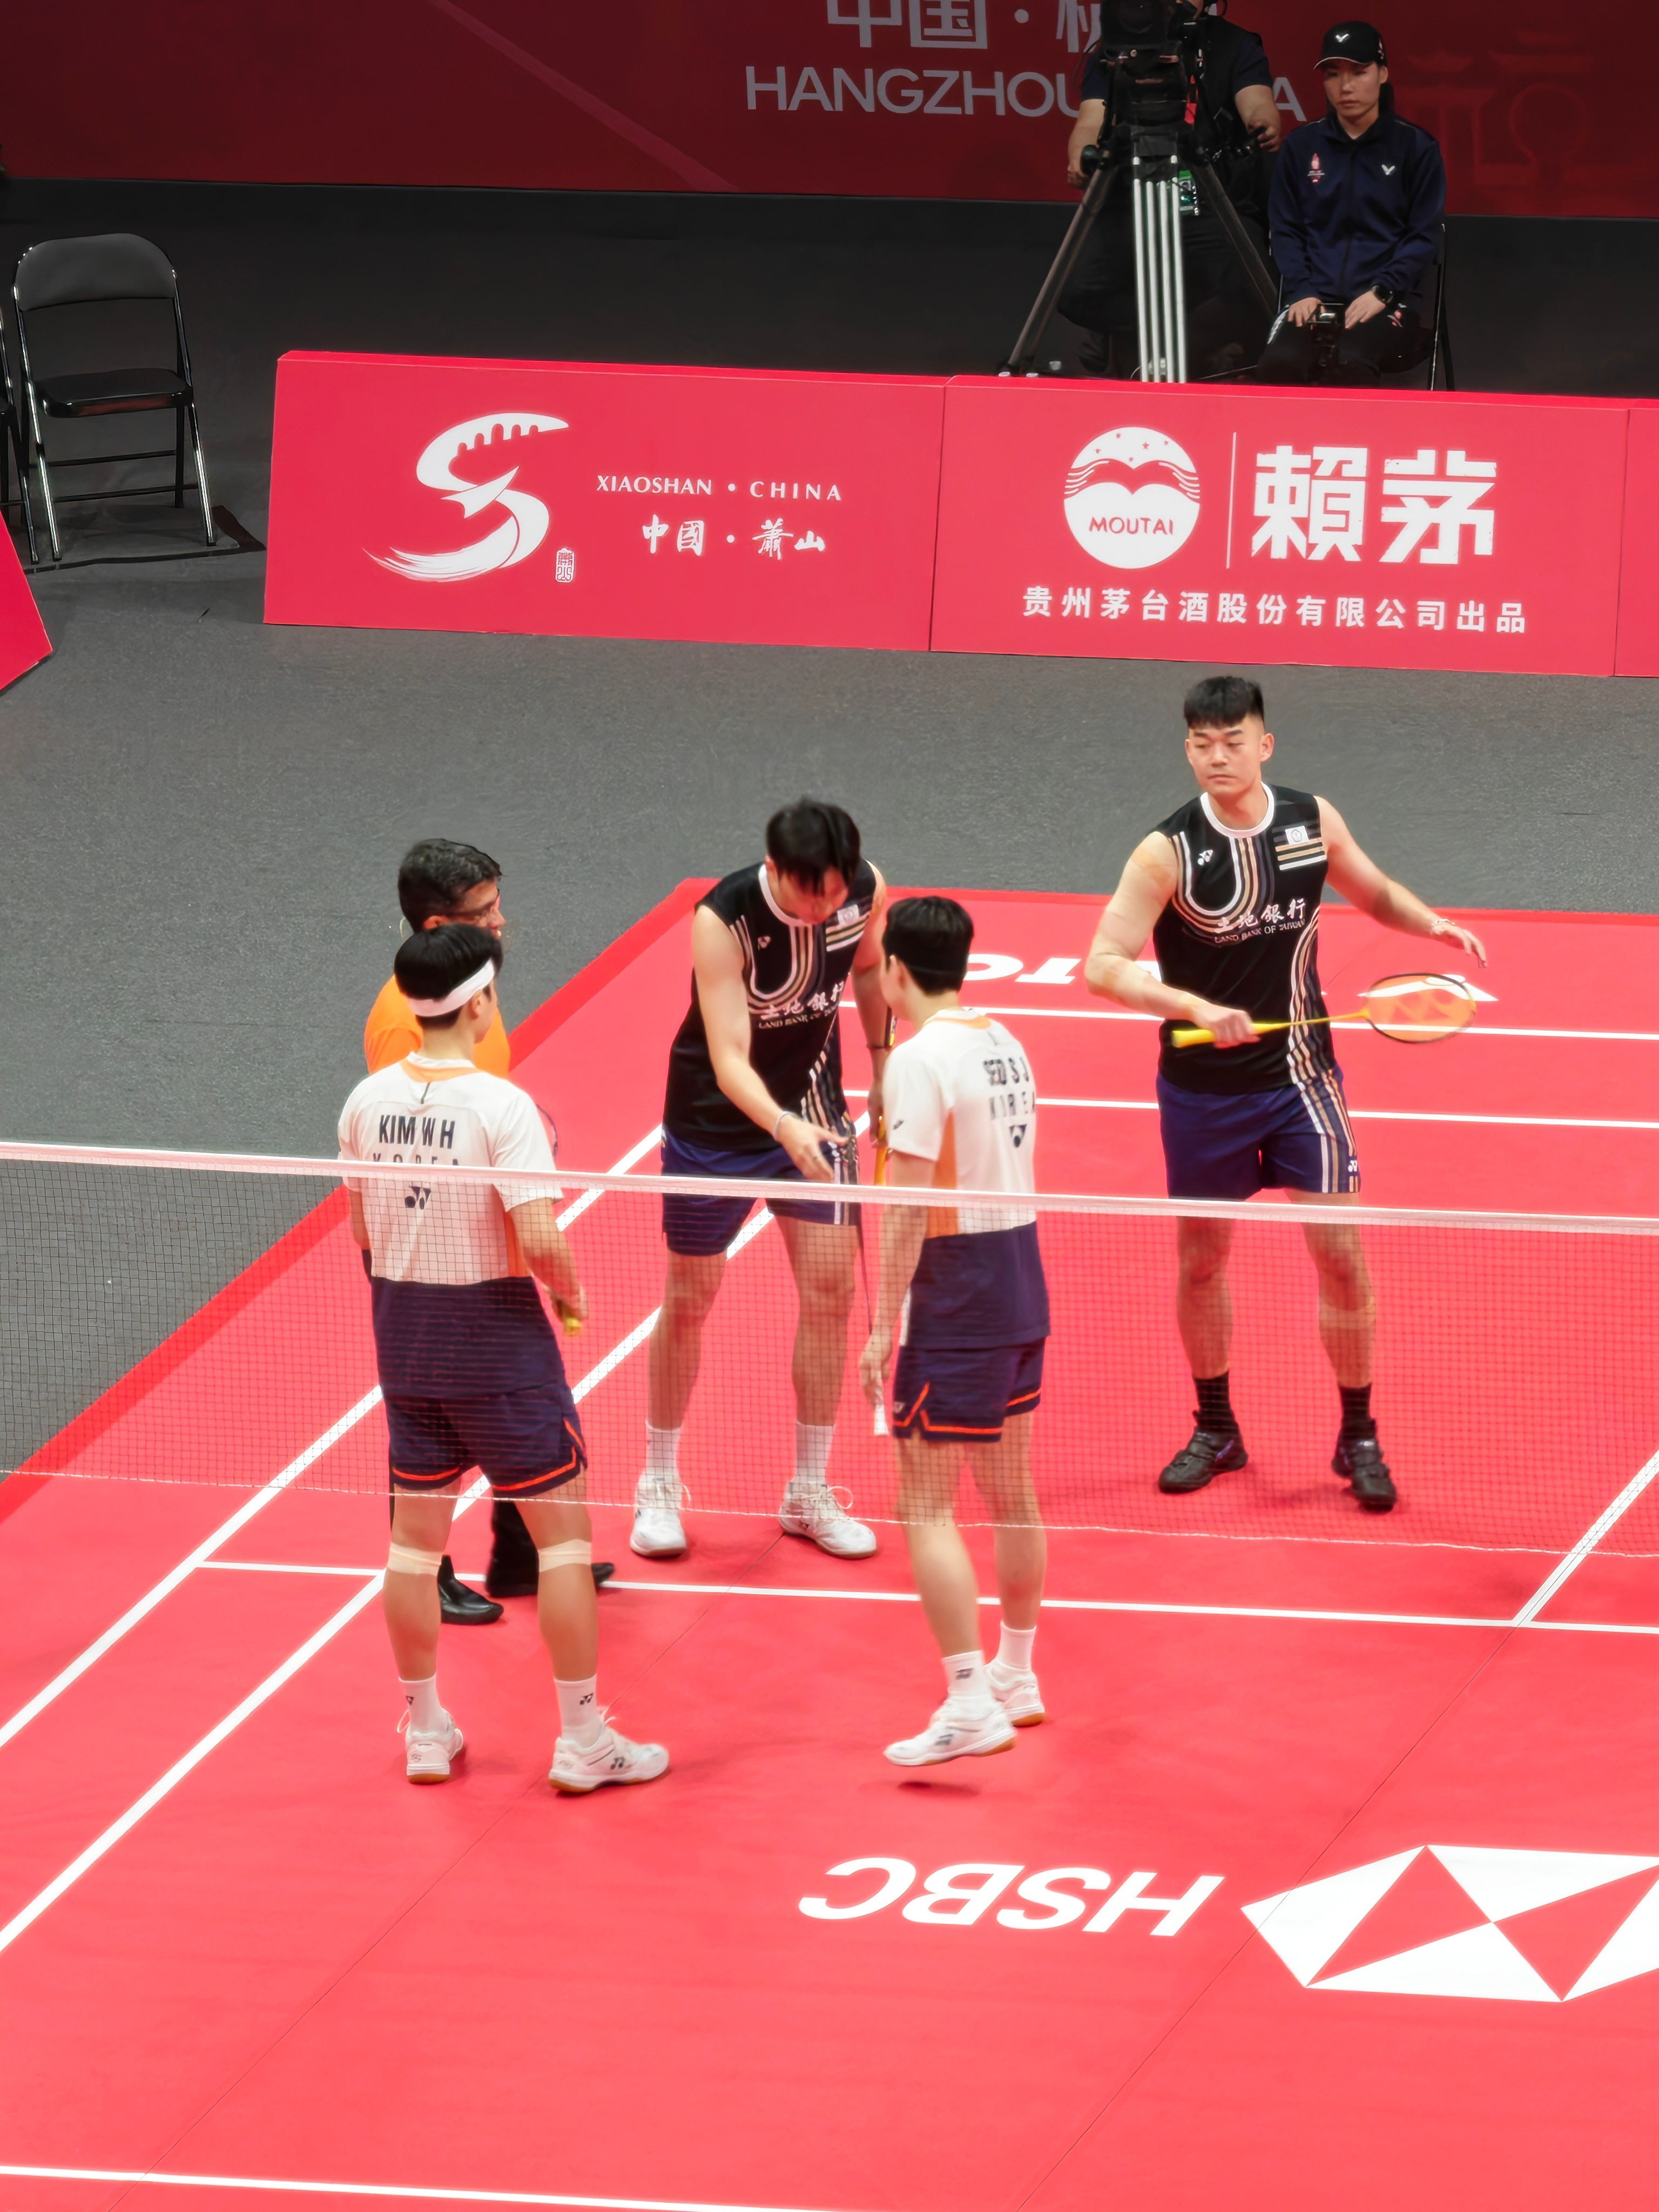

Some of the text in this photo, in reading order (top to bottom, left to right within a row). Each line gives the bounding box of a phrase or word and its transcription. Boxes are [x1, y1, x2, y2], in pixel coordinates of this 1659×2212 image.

[597, 475, 712, 495] XIAOSHAN
[750, 481, 841, 501] CHINA
[1089, 516, 1174, 535] MOUTAI
[1022, 585, 1526, 633] 贵州茅台酒股份有限公司出品
[1264, 925, 1277, 934] OF
[379, 1114, 416, 1145] KIM
[798, 1857, 1225, 1937] HSBC
